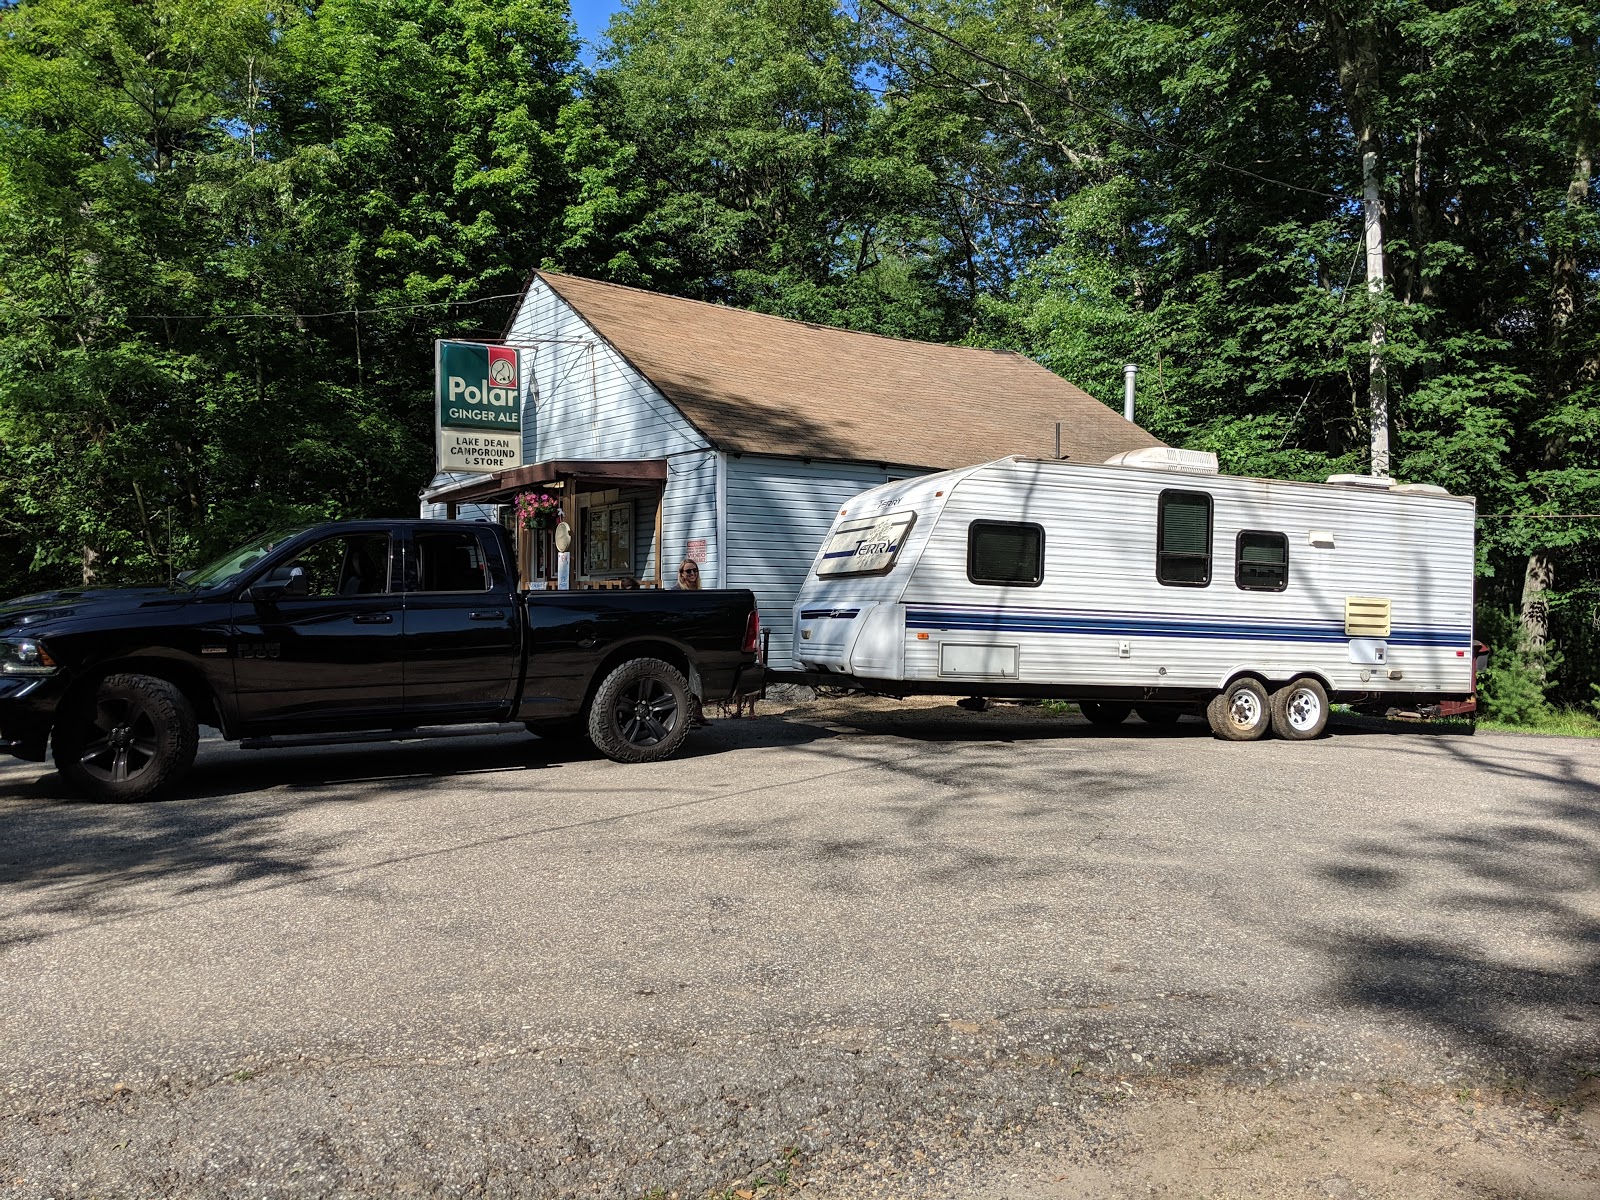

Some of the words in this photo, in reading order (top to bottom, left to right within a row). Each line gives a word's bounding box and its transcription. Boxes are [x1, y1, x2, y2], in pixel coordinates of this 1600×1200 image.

[448, 376, 519, 406] Polar
[449, 408, 495, 421] GINGER
[498, 412, 518, 423] ALE
[456, 437, 480, 446] LAKE
[484, 438, 509, 448] DEAN
[450, 446, 515, 458] CAMPGROUND
[465, 457, 471, 465] &
[473, 458, 504, 467] STORE
[853, 538, 897, 556] TERRY
